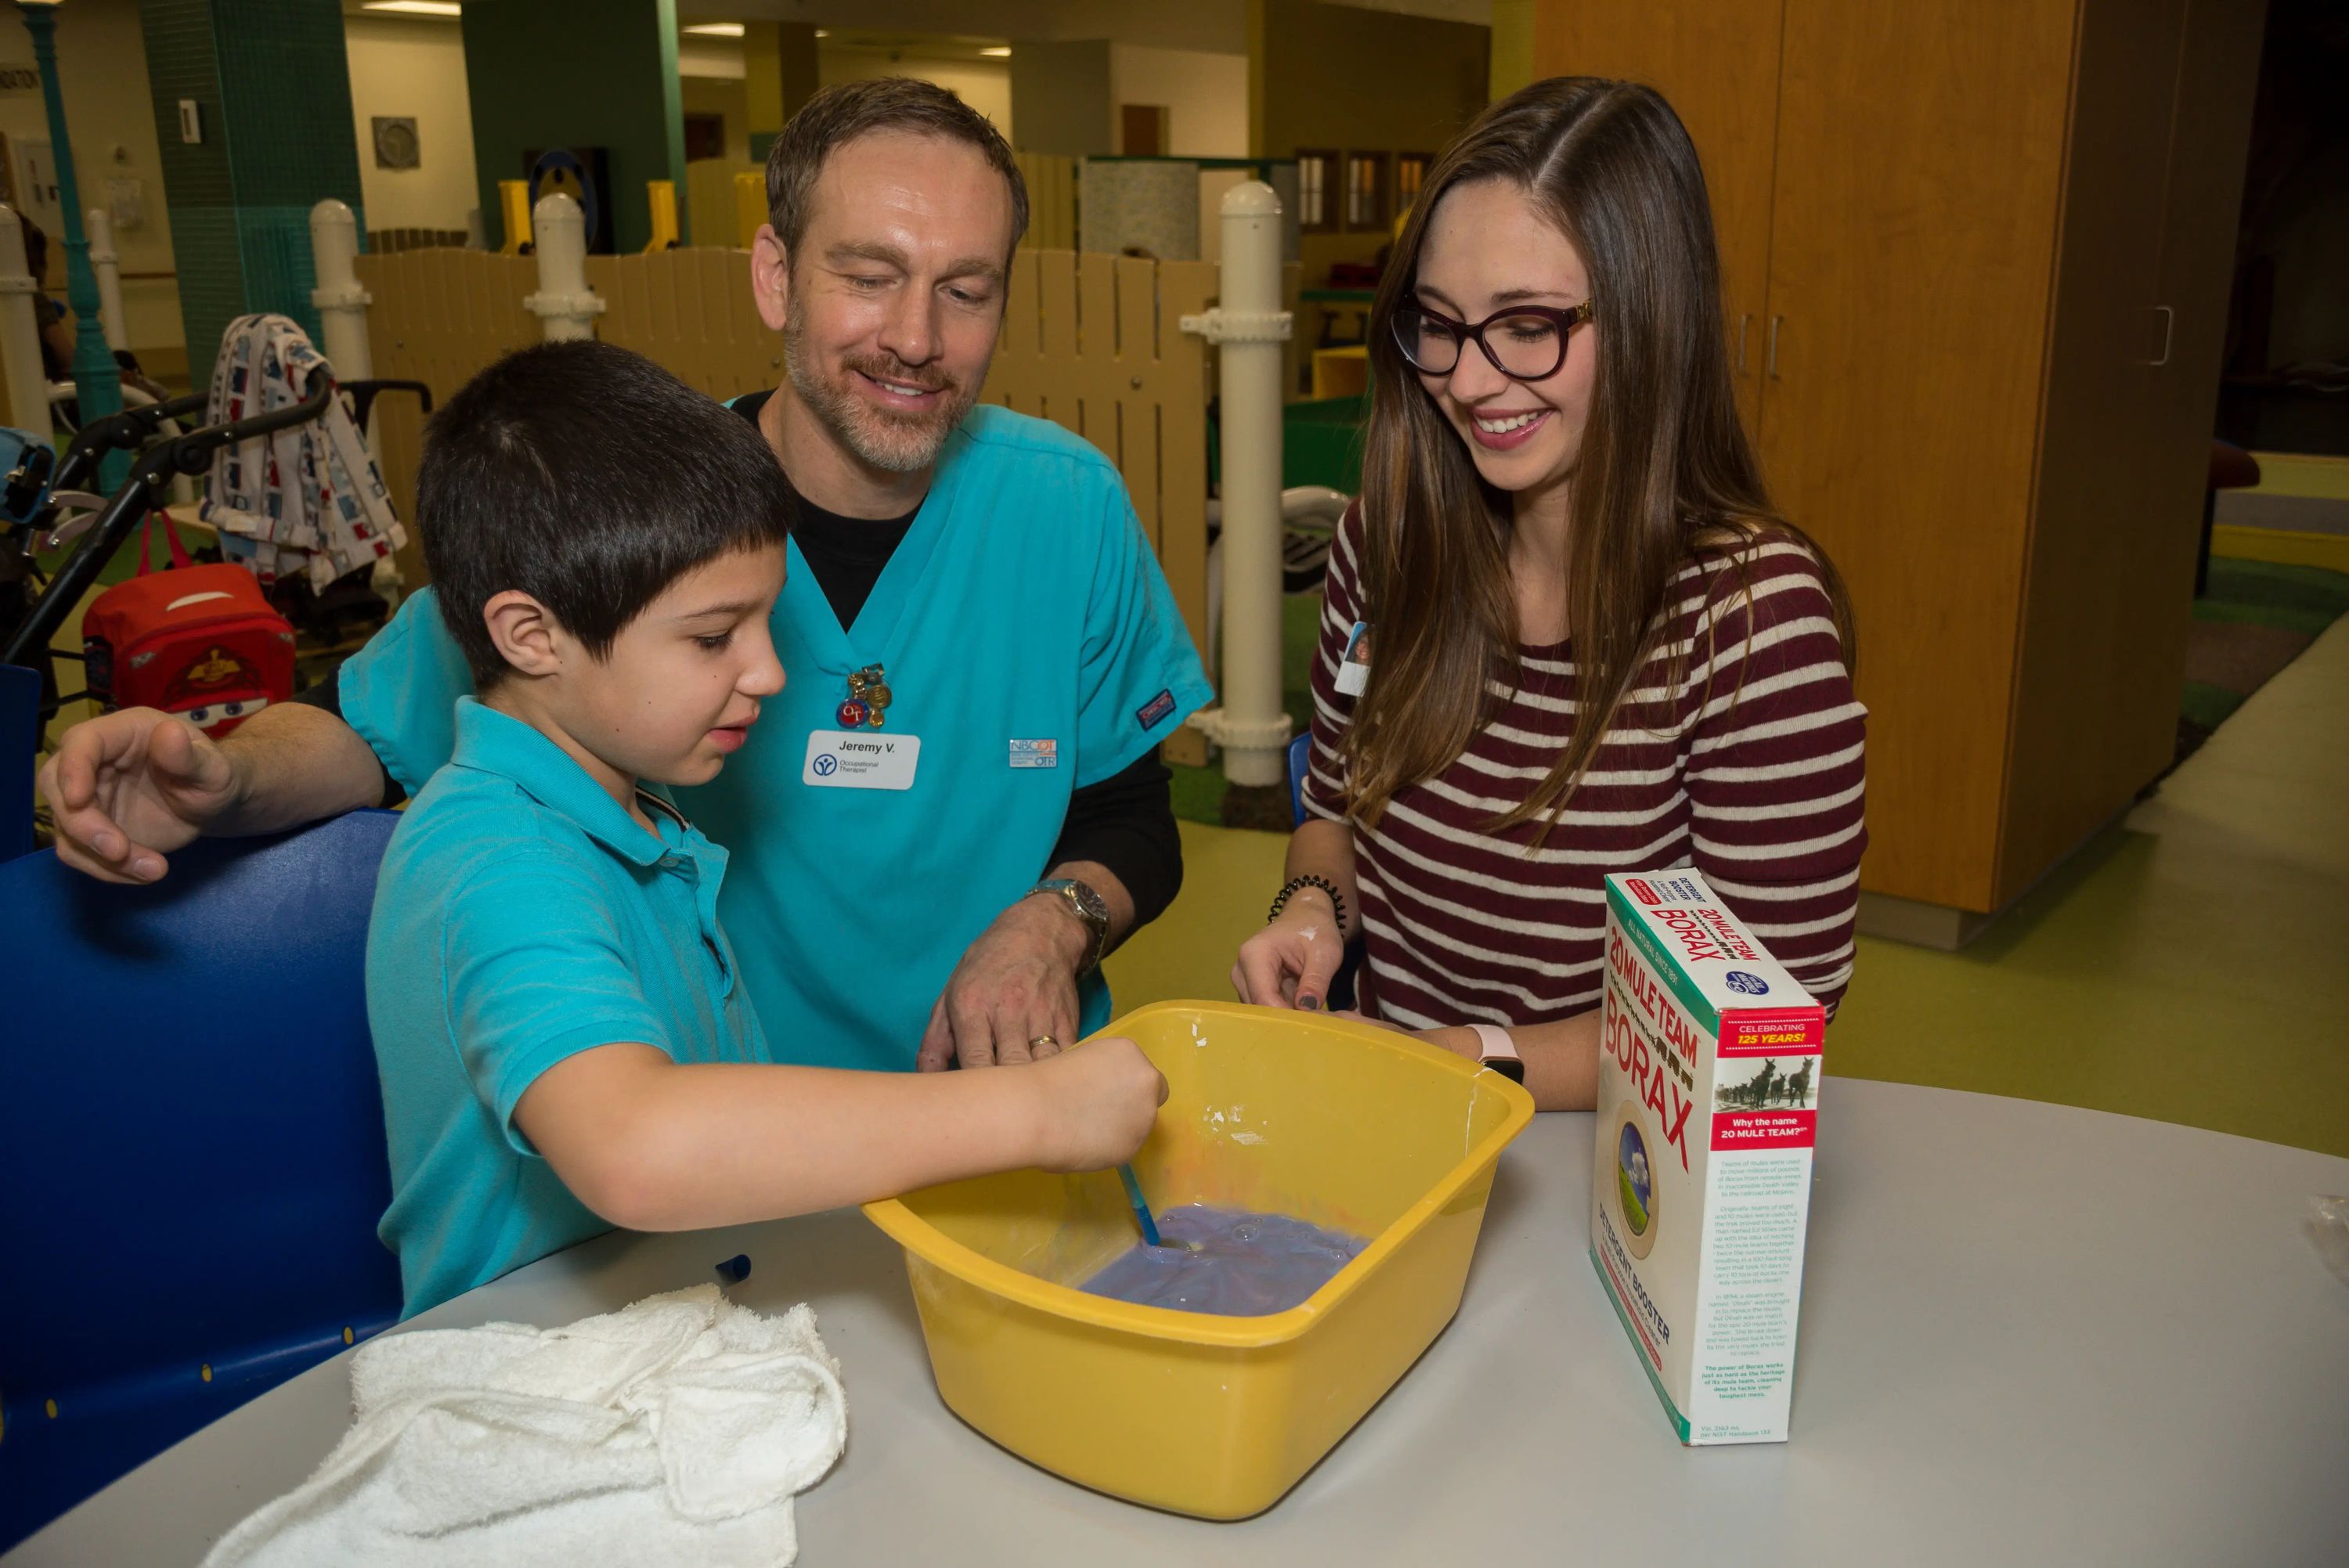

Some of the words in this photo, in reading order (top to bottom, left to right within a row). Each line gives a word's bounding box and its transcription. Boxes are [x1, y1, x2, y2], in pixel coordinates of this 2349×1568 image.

[843, 705, 861, 721] OT
[839, 741, 882, 754] Jeremy
[886, 744, 894, 752] V.
[1669, 881, 1691, 900] BOOSTER
[1679, 878, 1706, 903] DETERGENT
[1698, 910, 1722, 919] 20
[1651, 910, 1726, 961] BORAX
[1709, 921, 1741, 939] MULE
[1729, 940, 1760, 960] TEAM
[1610, 926, 1622, 975] 20
[1624, 949, 1657, 1019] MULE
[1658, 993, 1698, 1069] TEAM
[1739, 1024, 1805, 1033] CELEBRATING
[1738, 1035, 1758, 1044] 125
[1762, 1033, 1806, 1043] YEARS!
[1605, 986, 1693, 1174] BORAX
[1733, 1119, 1753, 1127] Why
[1600, 1202, 1632, 1278] DETERGENT
[1633, 1274, 1669, 1345] BOOSTER
